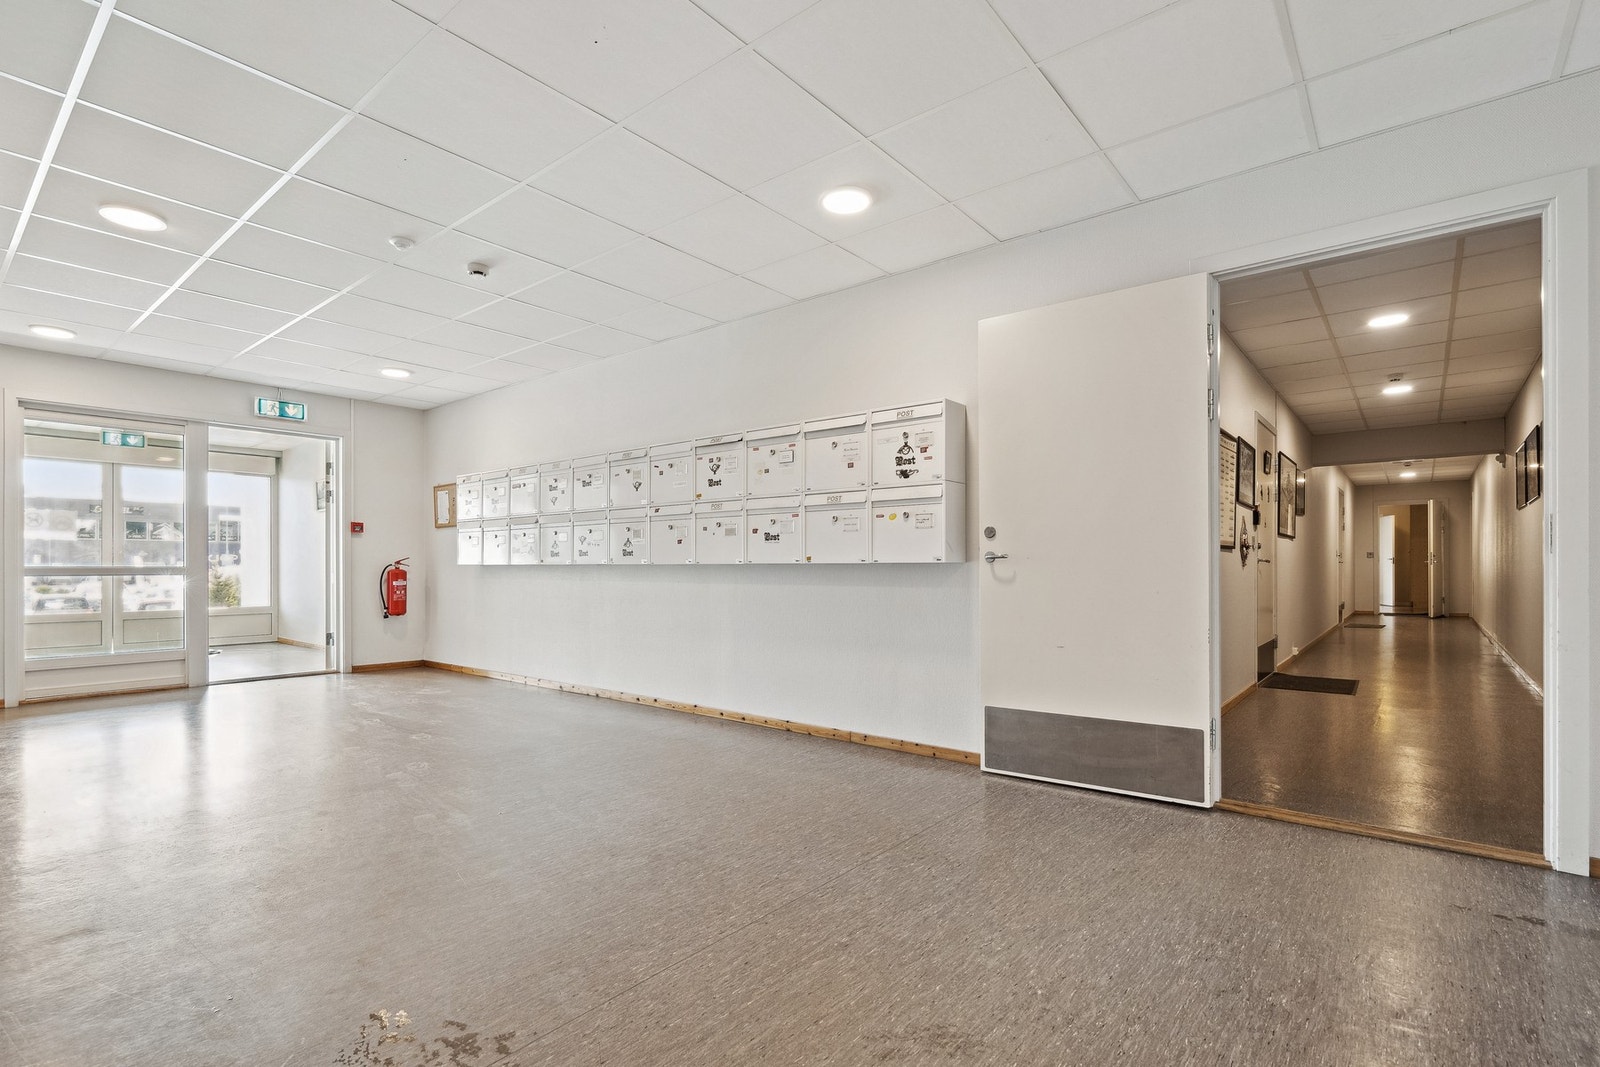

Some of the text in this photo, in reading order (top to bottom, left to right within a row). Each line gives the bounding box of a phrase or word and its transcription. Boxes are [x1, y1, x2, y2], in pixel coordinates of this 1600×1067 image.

[897, 409, 915, 418] POST
[895, 456, 916, 466] Post
[708, 479, 722, 487] Post
[826, 495, 843, 503] POST
[710, 503, 723, 511] POST
[764, 532, 780, 541] Post
